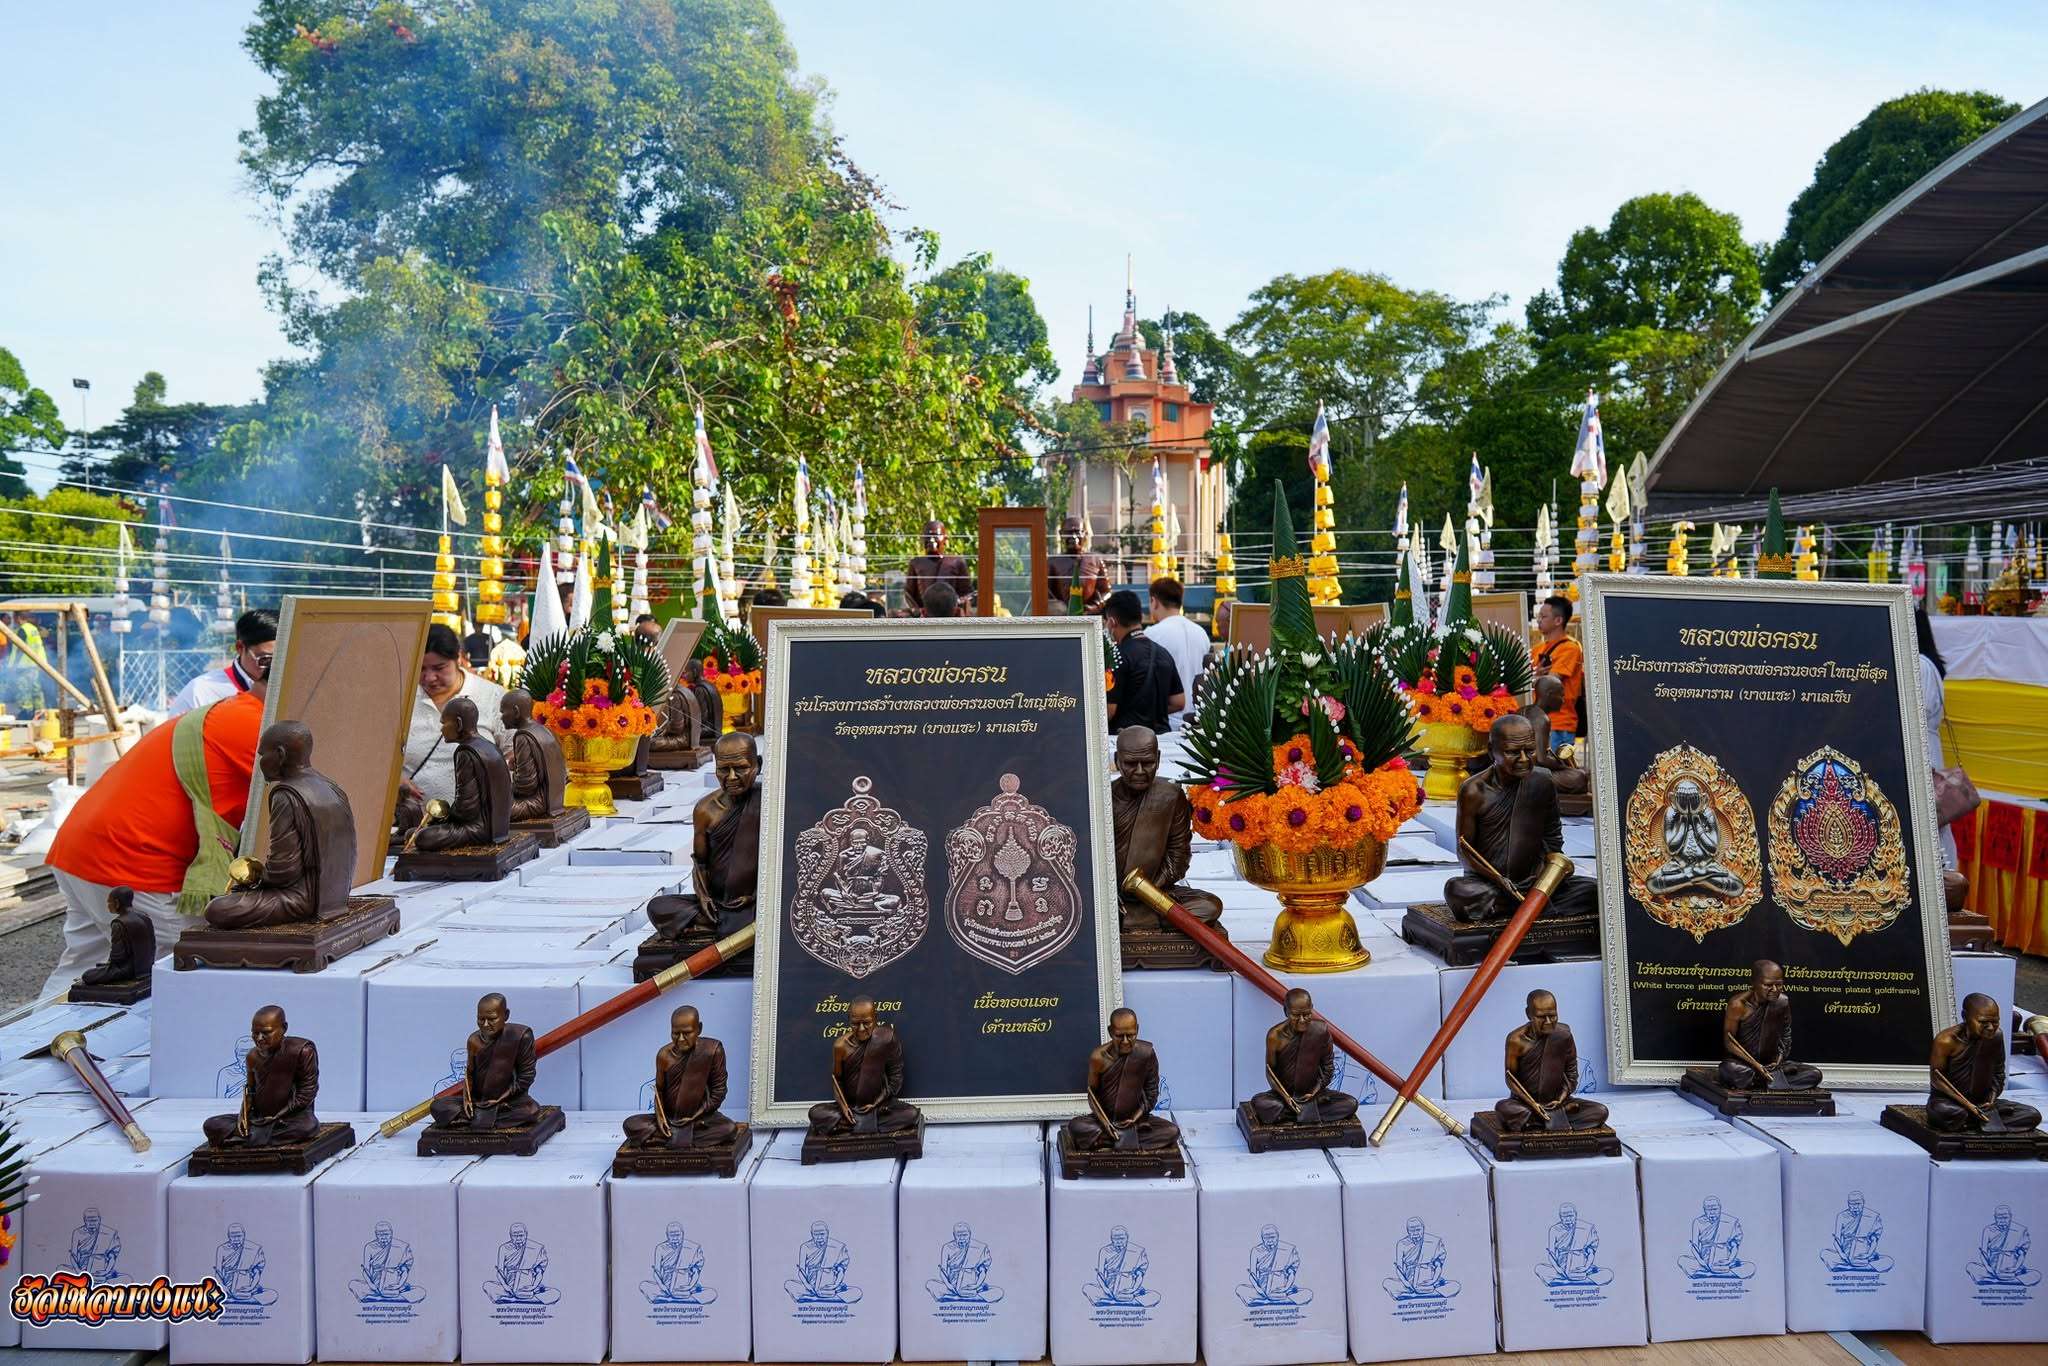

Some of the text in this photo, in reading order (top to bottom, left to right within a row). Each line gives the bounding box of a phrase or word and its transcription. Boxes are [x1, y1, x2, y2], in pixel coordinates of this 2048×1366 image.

[1679, 624, 1819, 652] หลวงพ่อครน
[865, 660, 1008, 685] หลวงพ่อครน
[1653, 683, 1852, 704] วัดอุตตมาราม (บางแซะ) มาเลเซีย
[834, 719, 1038, 740] วัดอุตตมาราม (บางแซะ) มาเลเซีย
[1632, 980, 1663, 990] (White
[1665, 981, 1695, 990] bronze
[1698, 983, 1725, 993] plated
[1812, 985, 1842, 994] bronze
[1845, 986, 1872, 996] plated
[1874, 986, 1921, 997] goldframe)
[973, 991, 1060, 1010] เนื้อทองแดง
[1824, 1000, 1881, 1015] (ด้านหลัง)
[981, 1017, 1053, 1035] (ด้านหลัง)
